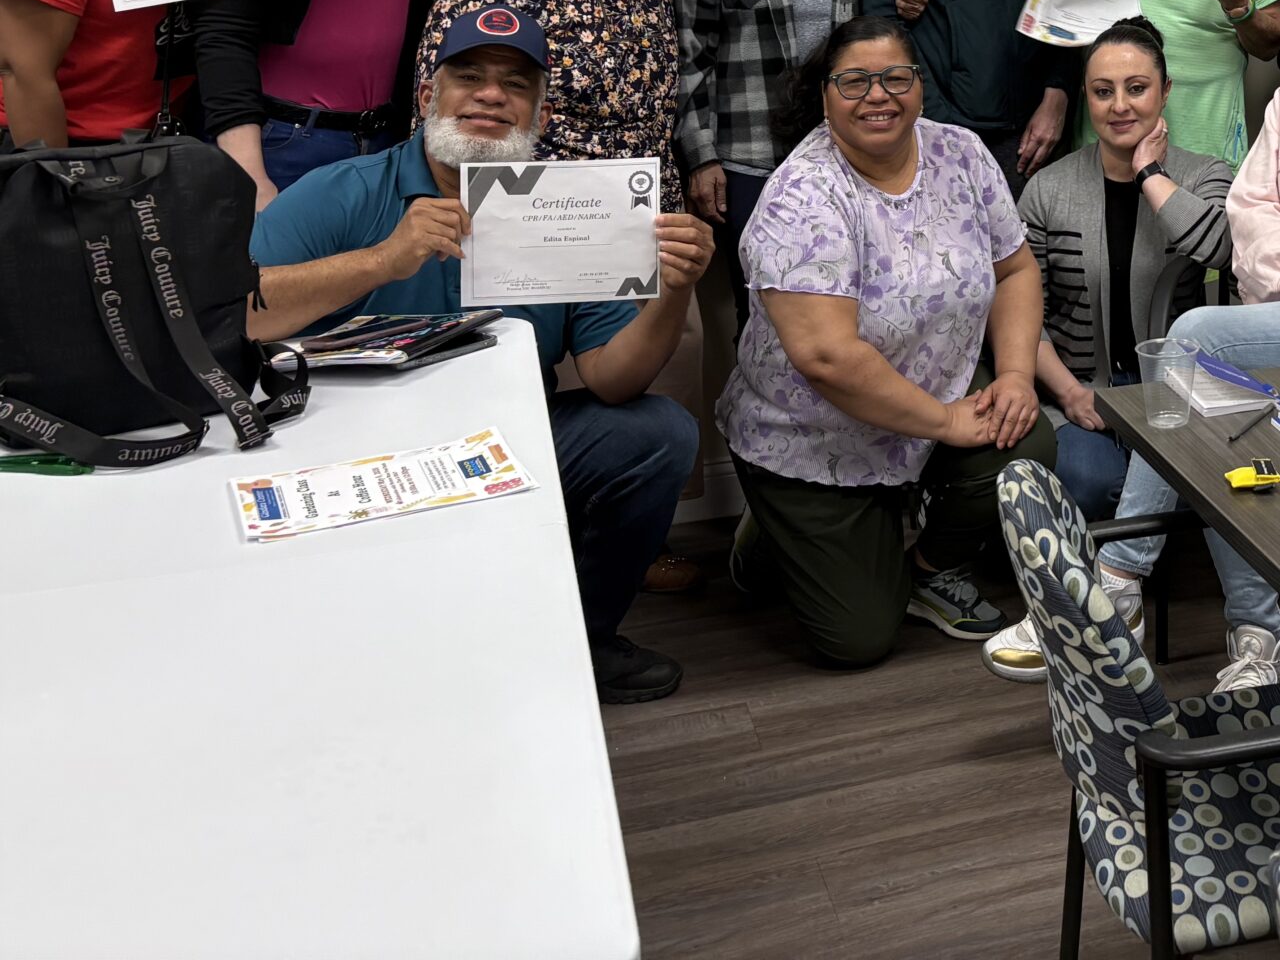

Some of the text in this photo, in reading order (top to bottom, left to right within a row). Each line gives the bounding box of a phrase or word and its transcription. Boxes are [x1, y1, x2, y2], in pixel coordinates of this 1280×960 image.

[522, 212, 612, 222] CPR/FA/AED/NARCAN
[532, 197, 602, 210] Certificate
[151, 247, 184, 319] Couture
[102, 290, 134, 362] Couture
[297, 479, 319, 519] Gardening Class
[356, 487, 372, 504] Coffee
